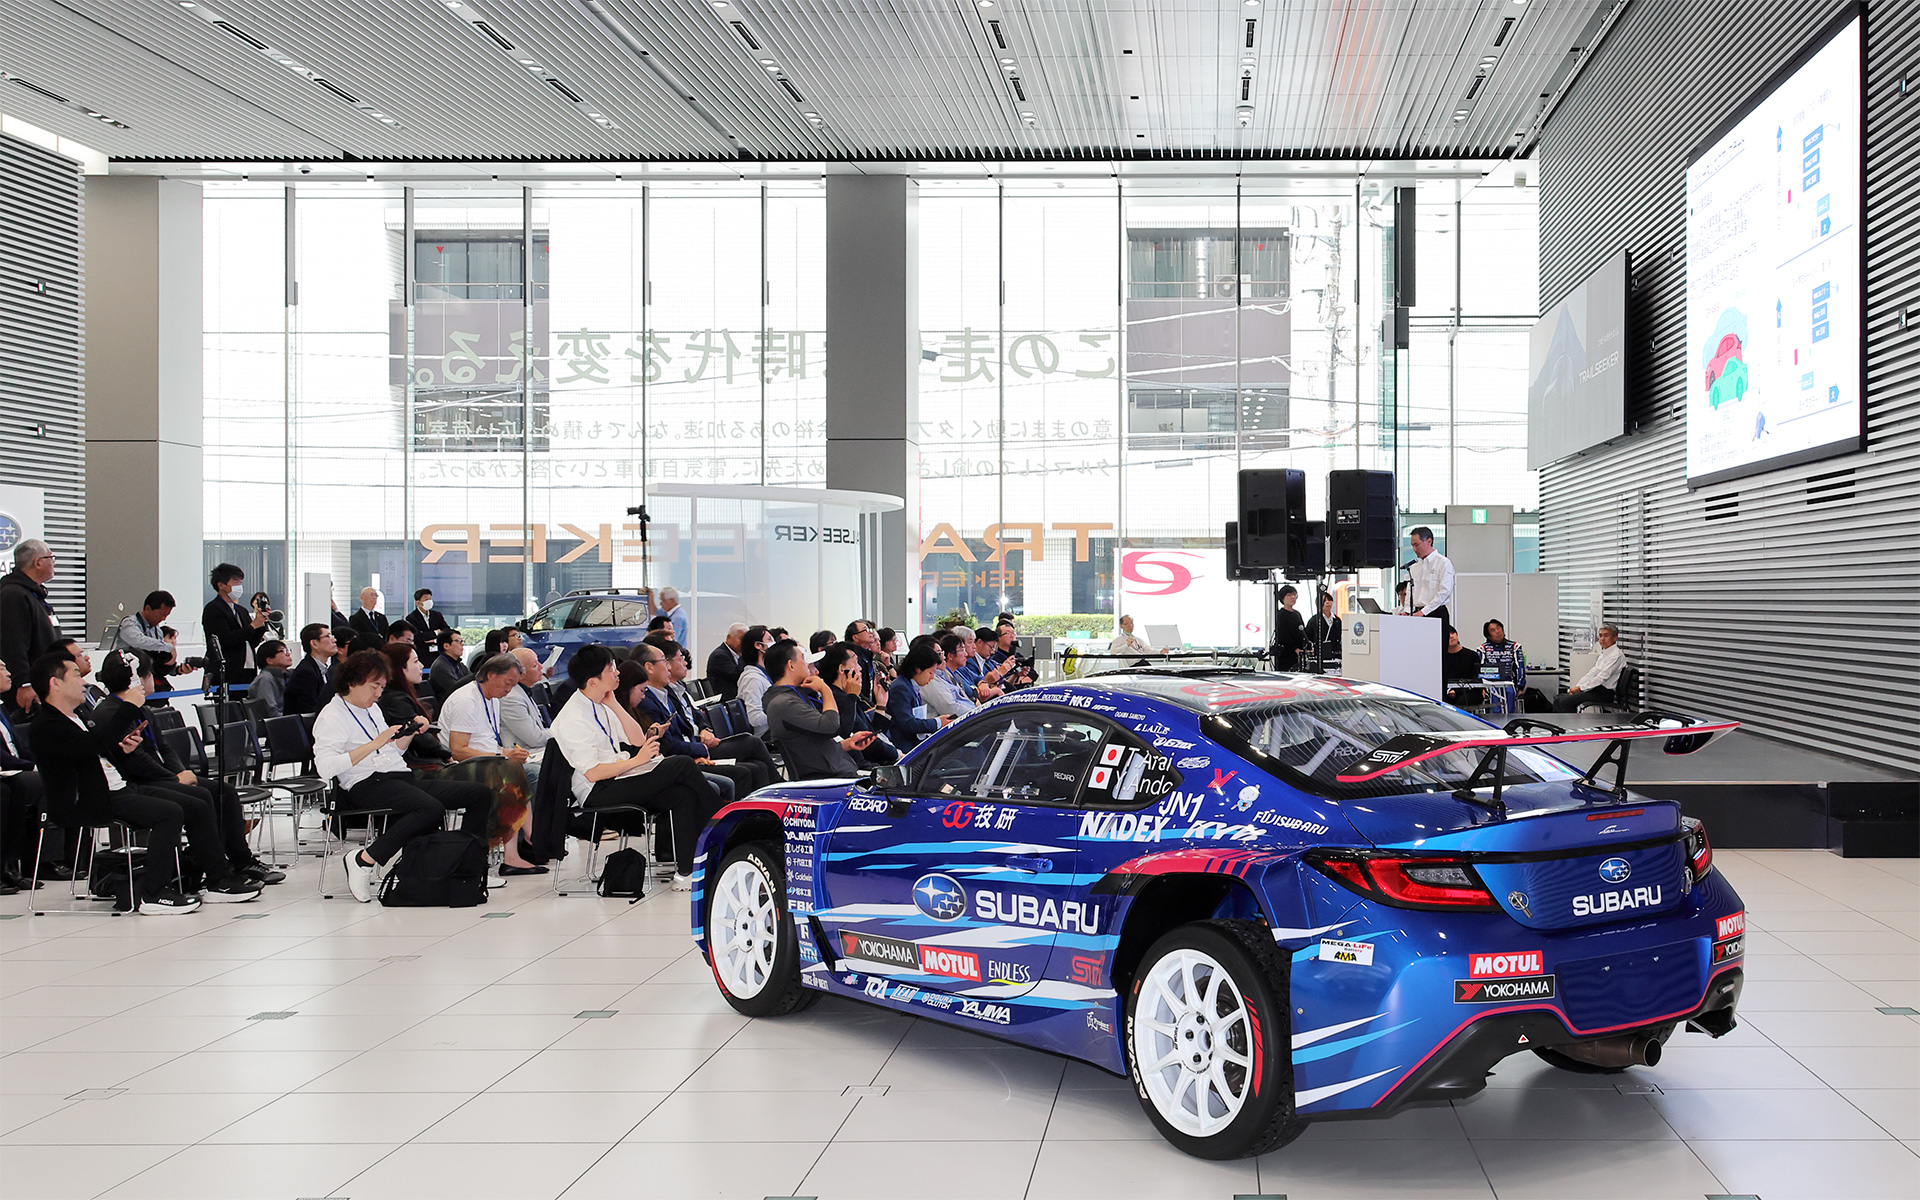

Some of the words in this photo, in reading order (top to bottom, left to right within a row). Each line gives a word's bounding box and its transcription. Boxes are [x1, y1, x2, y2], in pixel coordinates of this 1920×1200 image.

[1579, 350, 1619, 385] TRAILSEEKER
[847, 798, 888, 814] RECARO
[1078, 811, 1171, 843] NADEX
[746, 853, 777, 894] ADVAN
[787, 899, 815, 913] FBK
[974, 889, 1100, 935] SUBARU
[1572, 885, 1662, 917] SUBARU
[858, 939, 914, 964] YOKOHAMA
[925, 951, 979, 977] MOTUL
[988, 959, 1031, 983] ENDLESS
[1473, 956, 1541, 976] MOTUL
[1483, 980, 1550, 998] YOKOHAMA
[961, 998, 1011, 1022] YAJIMA
